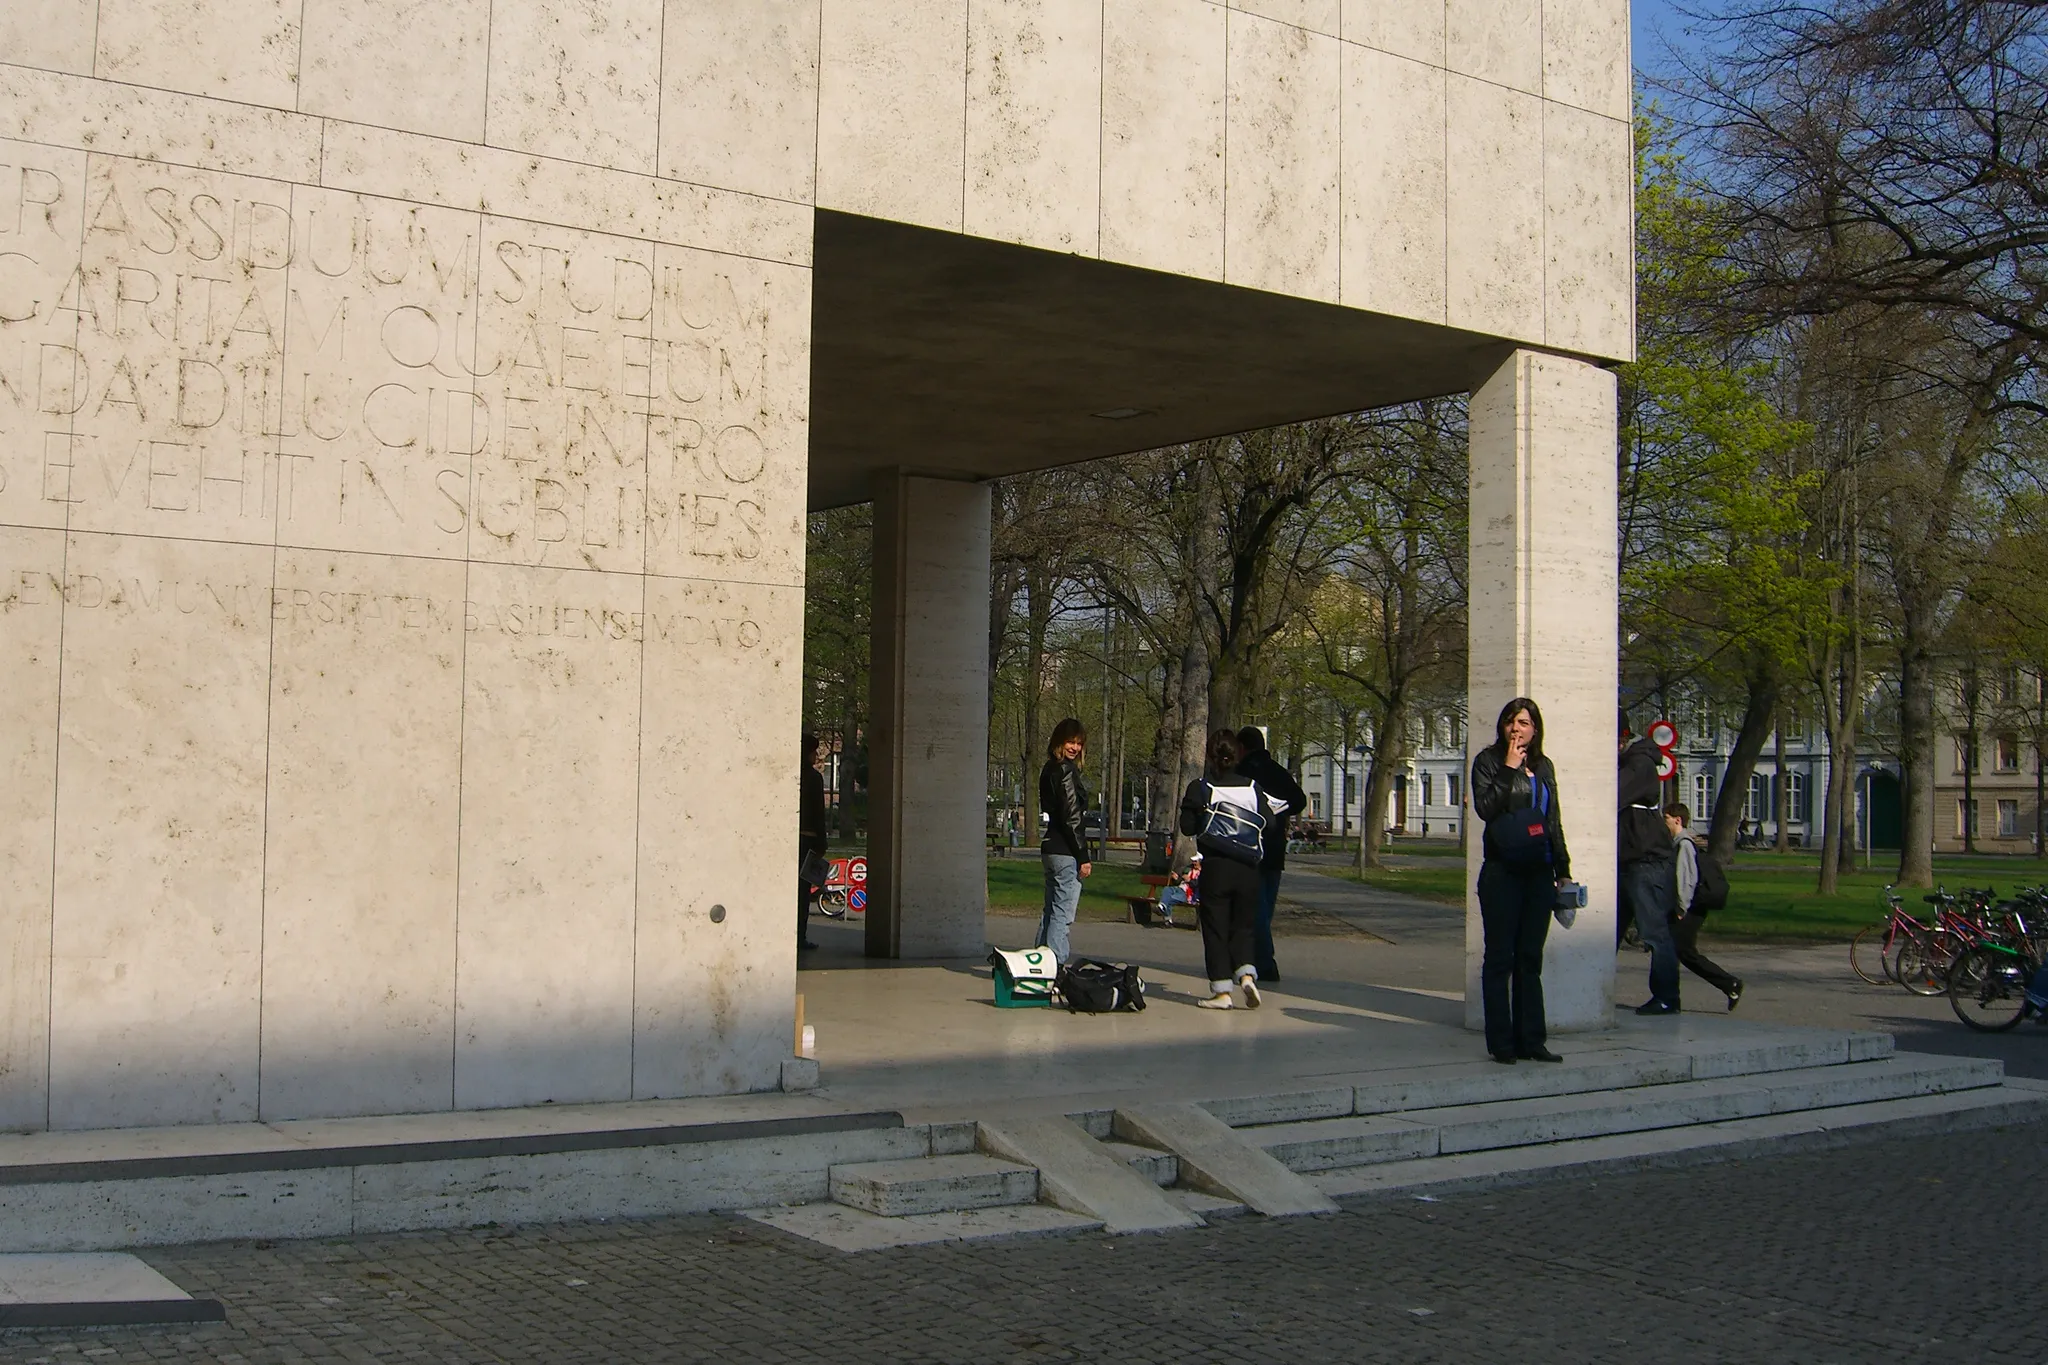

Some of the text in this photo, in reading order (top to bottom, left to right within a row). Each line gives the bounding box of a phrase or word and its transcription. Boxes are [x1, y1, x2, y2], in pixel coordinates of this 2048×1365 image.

[82, 183, 472, 299] ASSIDUUM
[494, 240, 770, 340] STUDIUM
[175, 358, 539, 462] DILUCIDE
[565, 404, 766, 483] INTRO
[381, 305, 600, 392] QUAE
[621, 334, 768, 416] EUM
[41, 431, 314, 523] EVEHIT
[338, 459, 408, 527] IN
[434, 469, 766, 560] SUBLIMES
